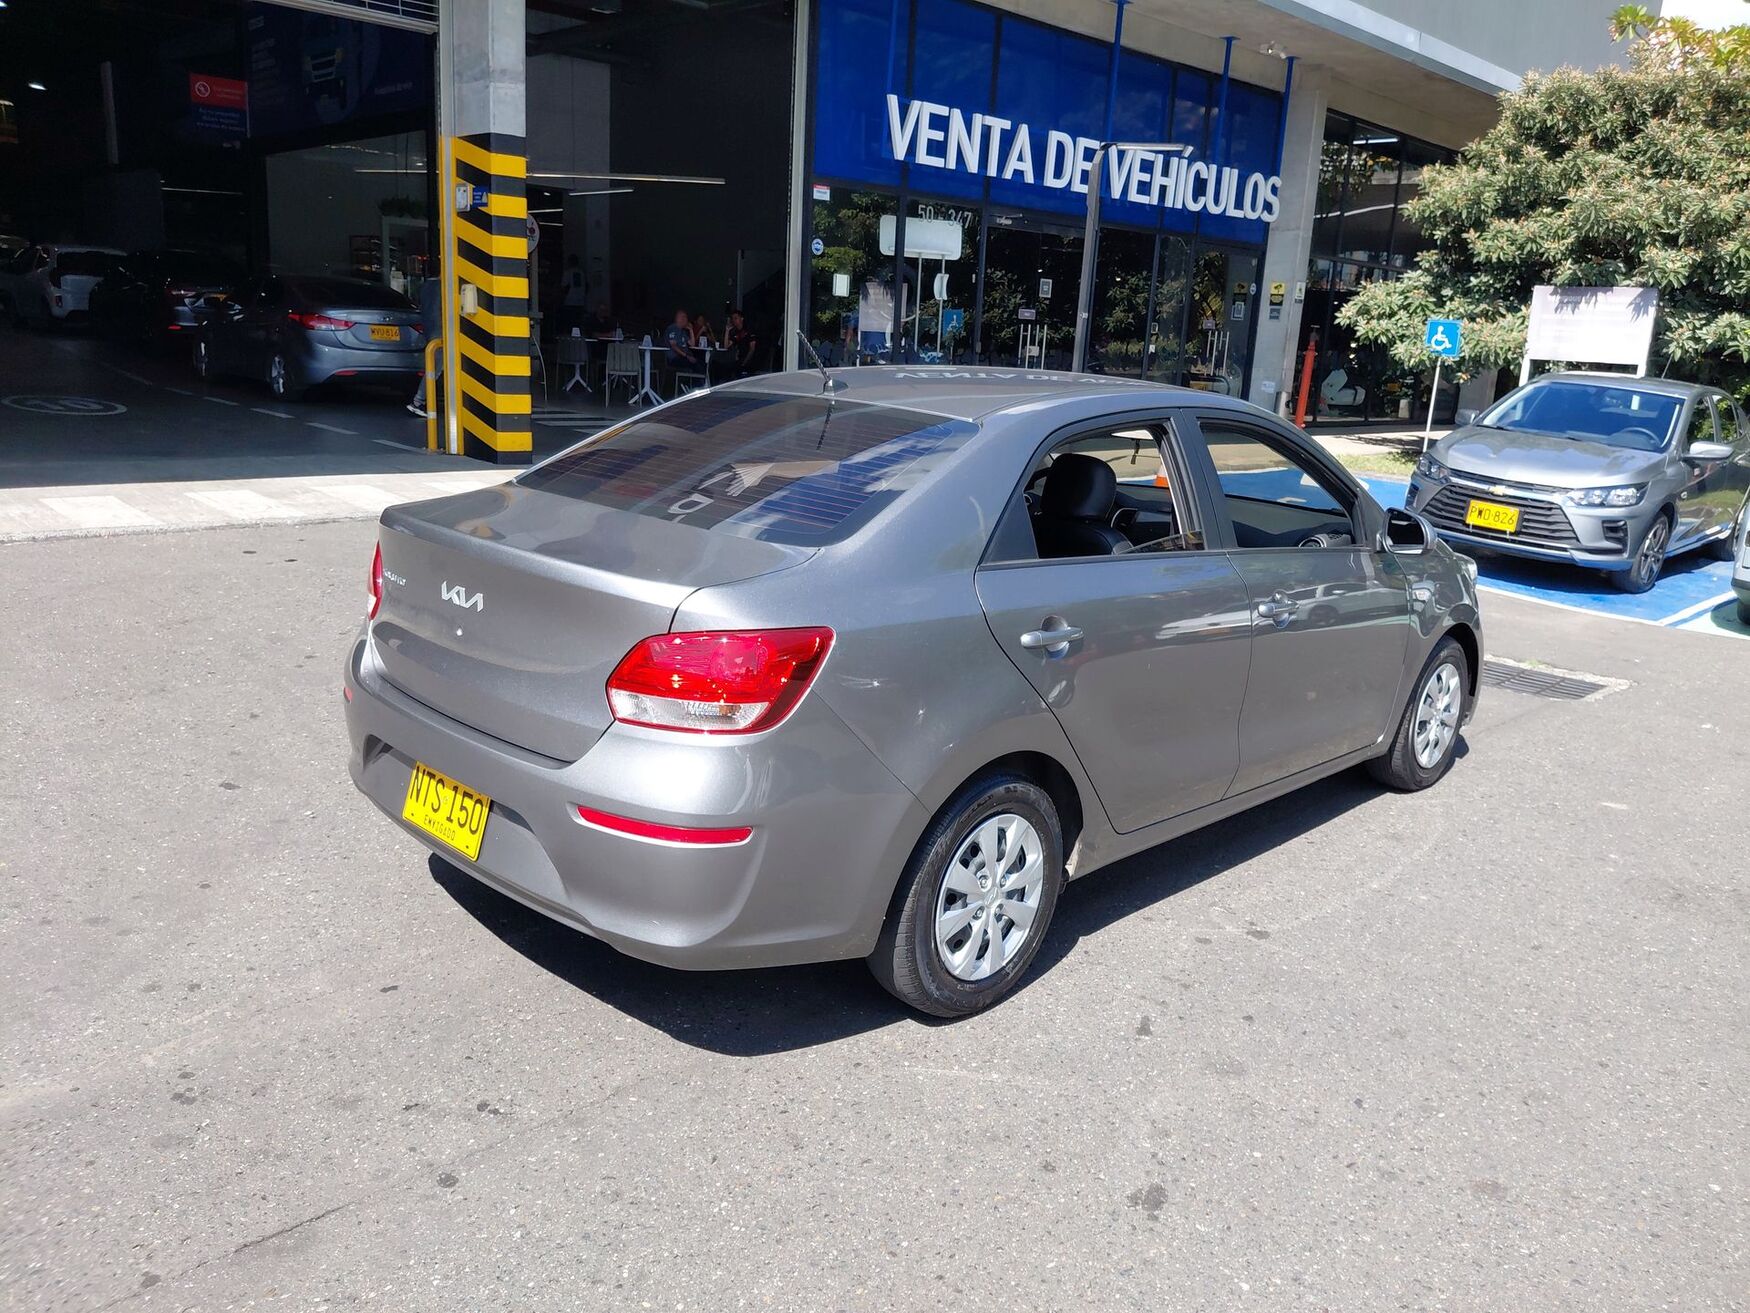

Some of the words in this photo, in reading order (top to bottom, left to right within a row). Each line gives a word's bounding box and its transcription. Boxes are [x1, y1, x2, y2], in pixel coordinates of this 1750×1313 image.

[887, 94, 1034, 183] VENTA
[1044, 129, 1102, 194] DE
[1108, 144, 1282, 223] VEHÍCULOS
[918, 204, 934, 223] 50
[948, 209, 972, 229] 347
[1494, 510, 1516, 525] 826
[441, 580, 484, 612] KIA
[410, 765, 446, 813] NTS
[446, 785, 485, 835] 150
